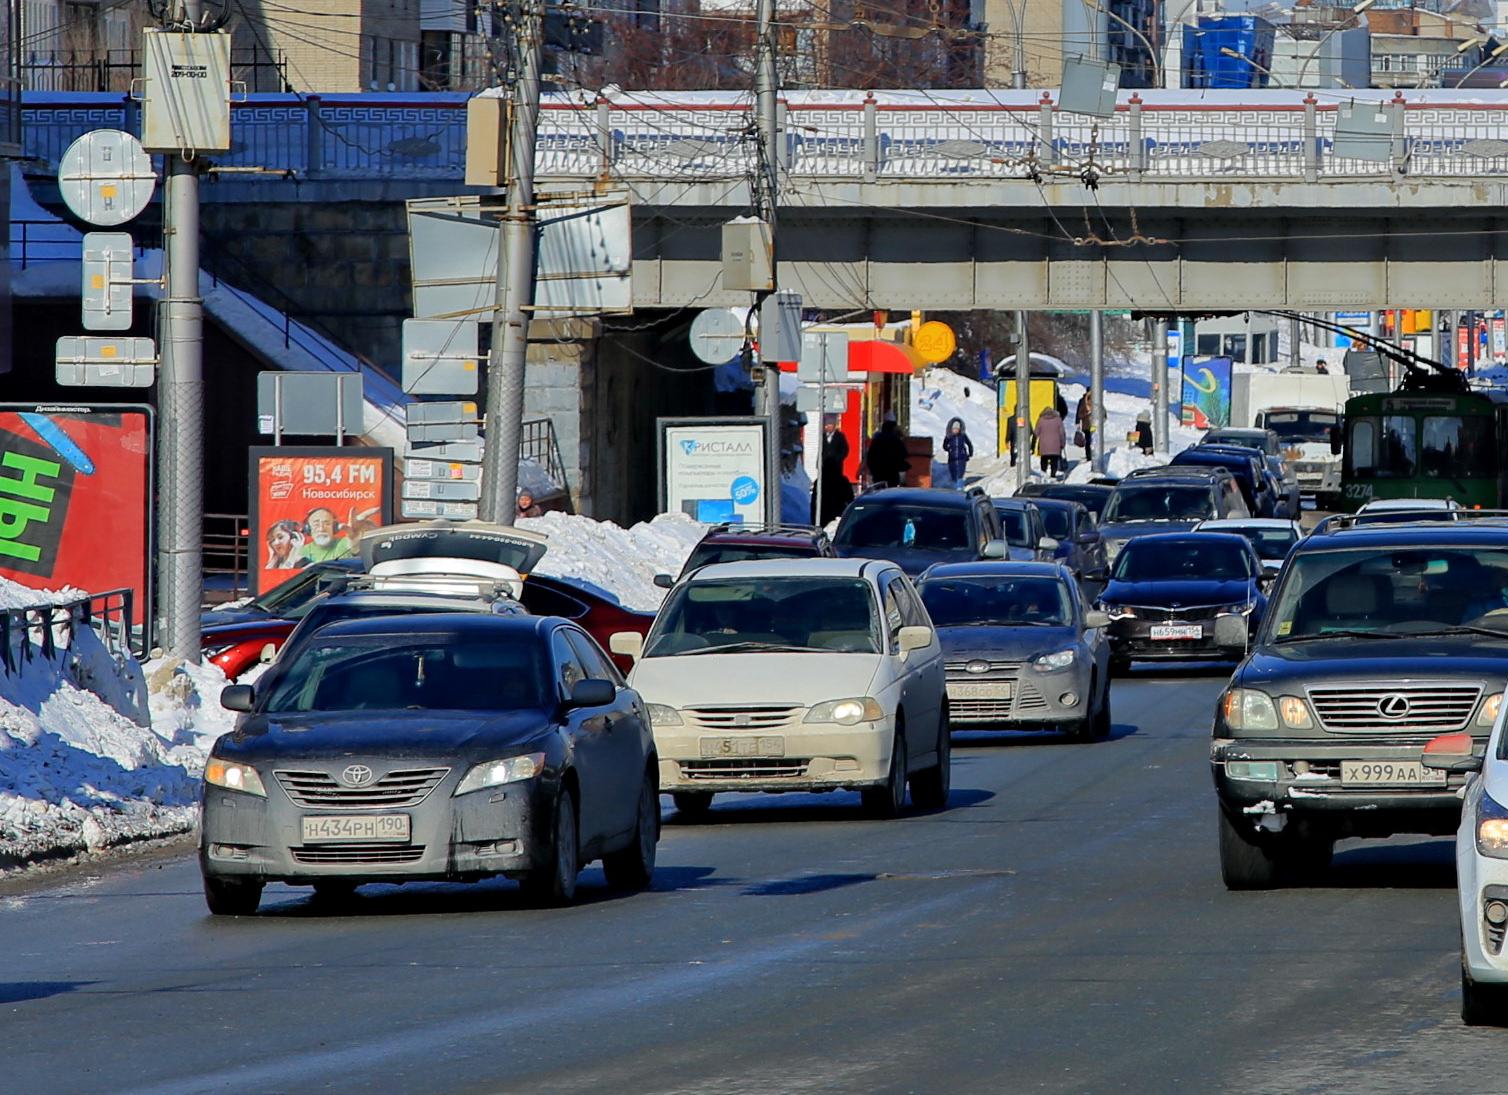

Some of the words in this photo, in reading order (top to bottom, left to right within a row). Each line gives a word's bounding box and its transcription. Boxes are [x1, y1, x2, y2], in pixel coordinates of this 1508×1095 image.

[303, 464, 342, 486] 95,4
[348, 464, 375, 484] FM
[303, 488, 375, 500] Новосибирск
[1345, 484, 1373, 498] 3274
[1349, 764, 1418, 781] Х999АА
[309, 820, 374, 837] Н434РН
[378, 818, 402, 830] 190
